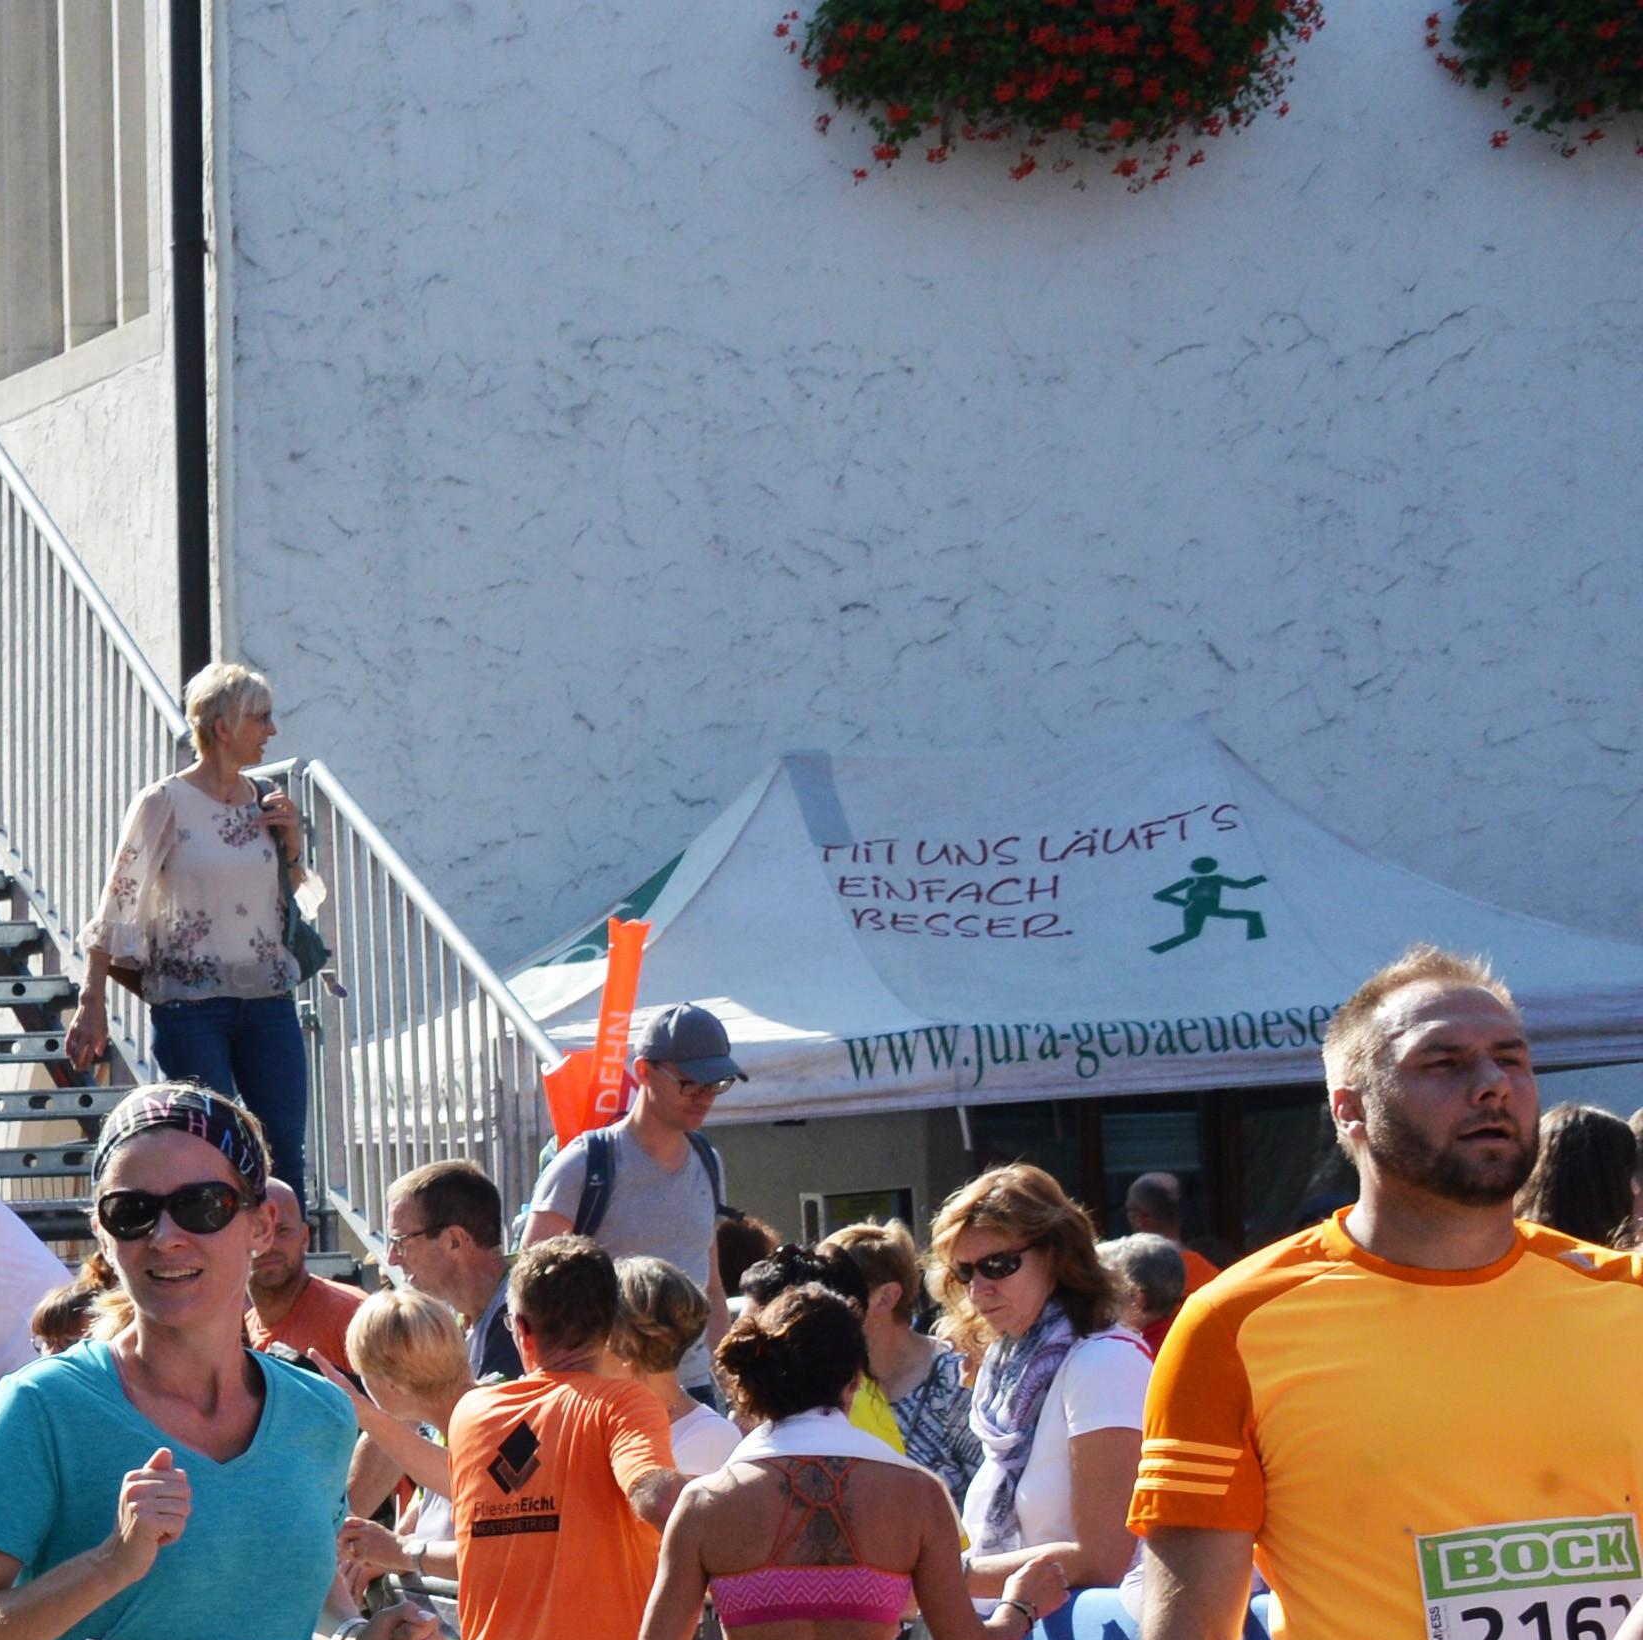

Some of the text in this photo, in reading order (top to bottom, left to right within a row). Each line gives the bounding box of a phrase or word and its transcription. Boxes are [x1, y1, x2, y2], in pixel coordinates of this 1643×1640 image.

[916, 836, 1021, 867] UNS
[851, 907, 1074, 938] BESSER.
[595, 1011, 630, 1113] DEHN
[1445, 1531, 1630, 1584] BOCK
